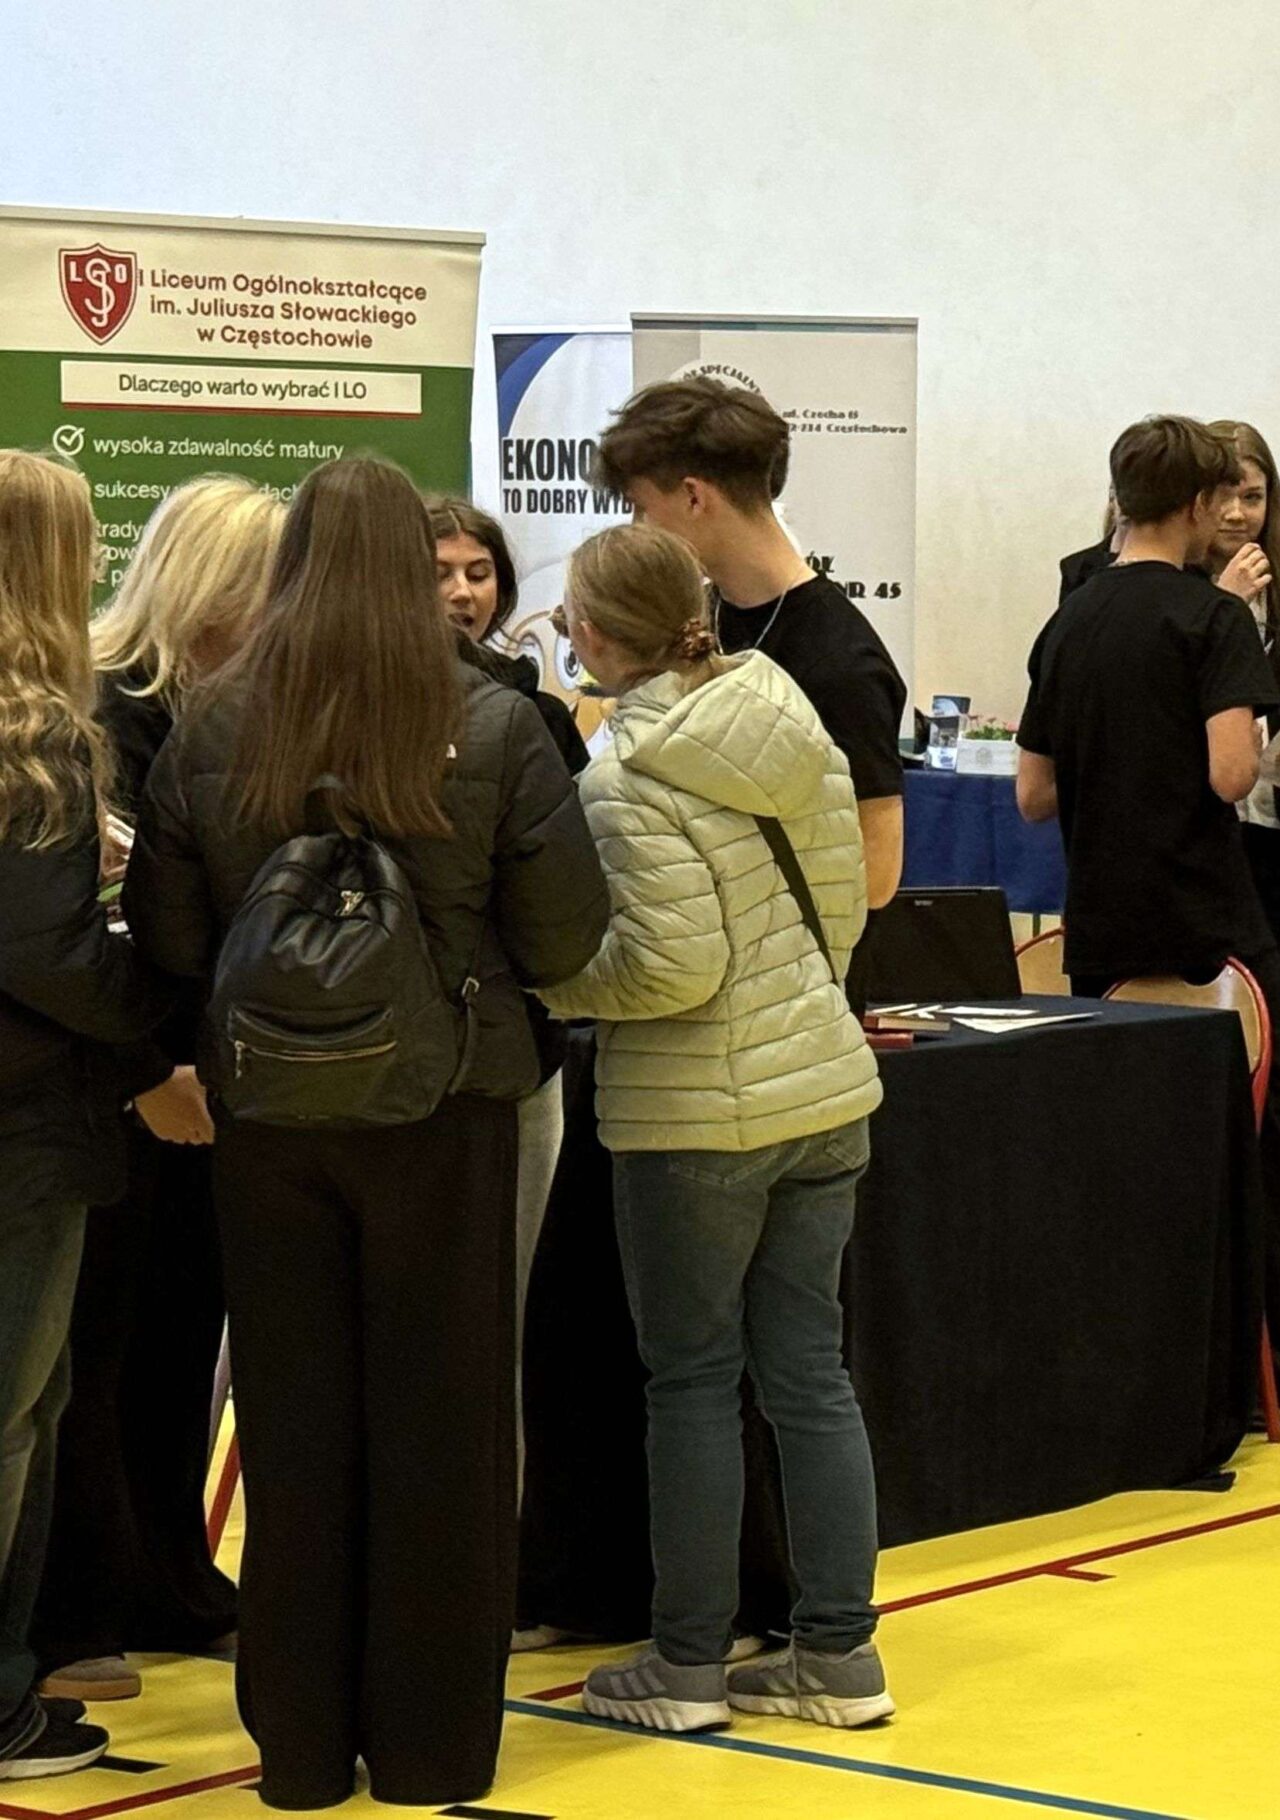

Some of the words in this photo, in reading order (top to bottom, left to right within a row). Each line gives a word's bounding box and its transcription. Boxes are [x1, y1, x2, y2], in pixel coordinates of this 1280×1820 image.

[151, 269, 226, 291] Liceum
[233, 273, 427, 304] Ogólnokształcące
[150, 294, 182, 315] im.
[187, 298, 274, 320] Juliusza
[281, 301, 417, 329] Słowackiego
[197, 327, 215, 342] w
[221, 325, 373, 349] Częstochowie
[119, 374, 203, 397] Dlaczego
[207, 380, 257, 396] warto
[263, 380, 329, 402] wybrać
[333, 382, 338, 397] I
[343, 382, 367, 398] LO
[93, 437, 164, 457] wysoka
[168, 438, 274, 458] zdawalność
[279, 443, 344, 463] matury
[502, 437, 600, 481] EKONO
[94, 480, 170, 502] sukcesy
[503, 488, 522, 514] TO
[527, 488, 588, 514] DOBRY
[592, 488, 633, 514] WYB
[874, 581, 902, 599] 45
